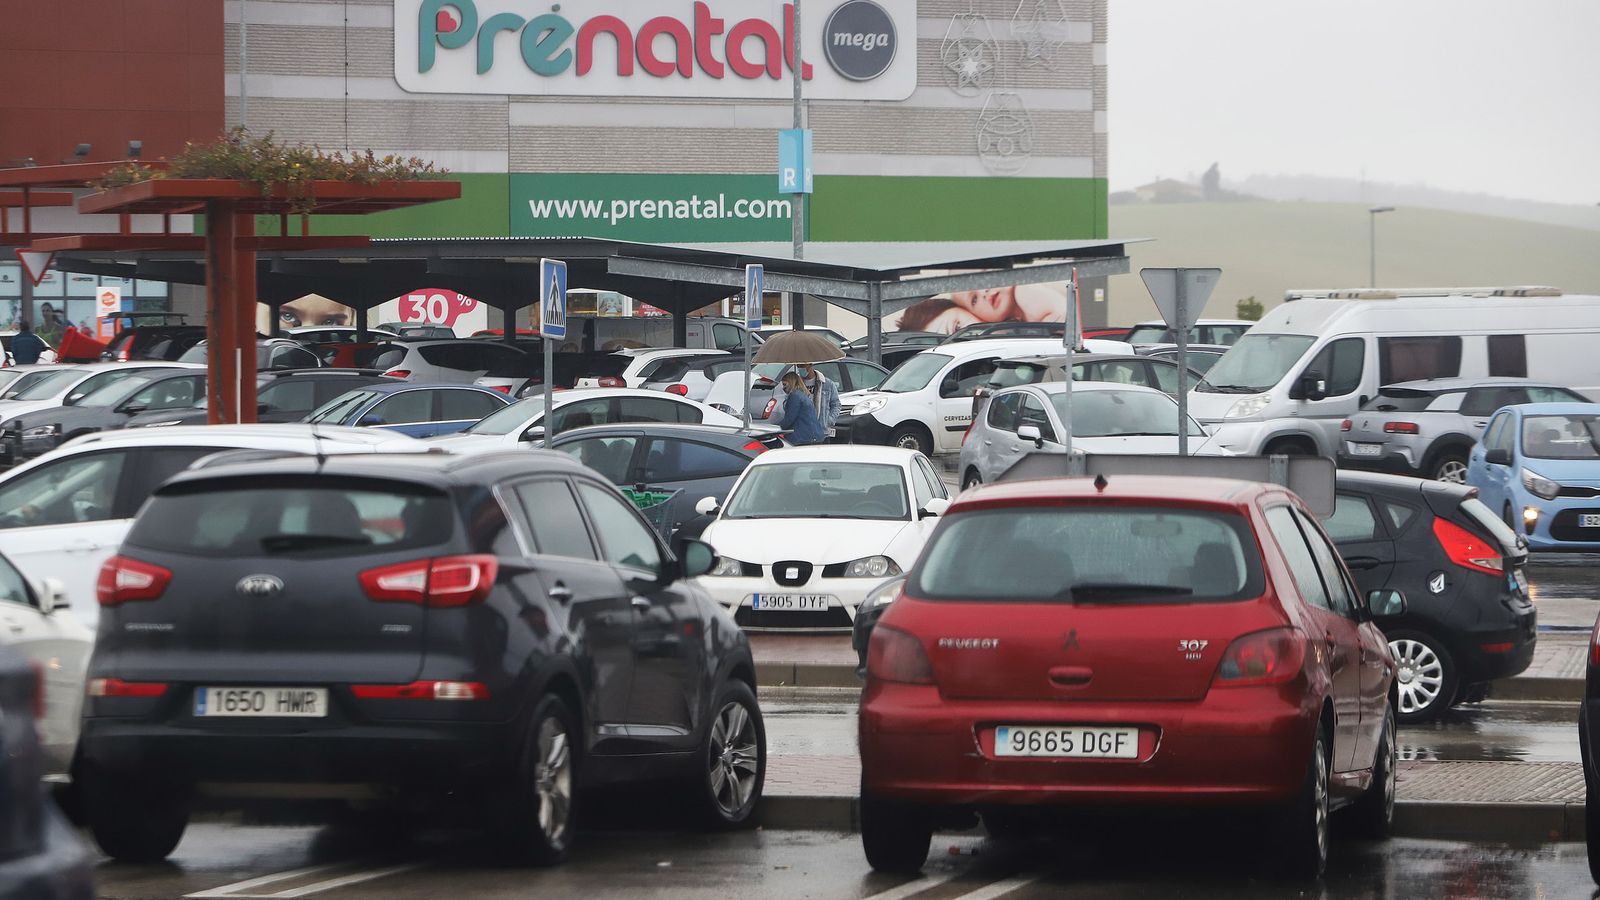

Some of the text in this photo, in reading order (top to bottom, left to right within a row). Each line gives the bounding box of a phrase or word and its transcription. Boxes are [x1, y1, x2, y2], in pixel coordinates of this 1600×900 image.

[418, 0, 814, 81] Prénatal
[833, 32, 889, 51] mega
[783, 167, 796, 187] R
[529, 193, 792, 225] www.prenatal.com
[761, 595, 826, 608] 5905 DYF
[1177, 639, 1208, 652] 307
[214, 690, 266, 712] 1650
[1012, 730, 1129, 754] 9665 DGF
